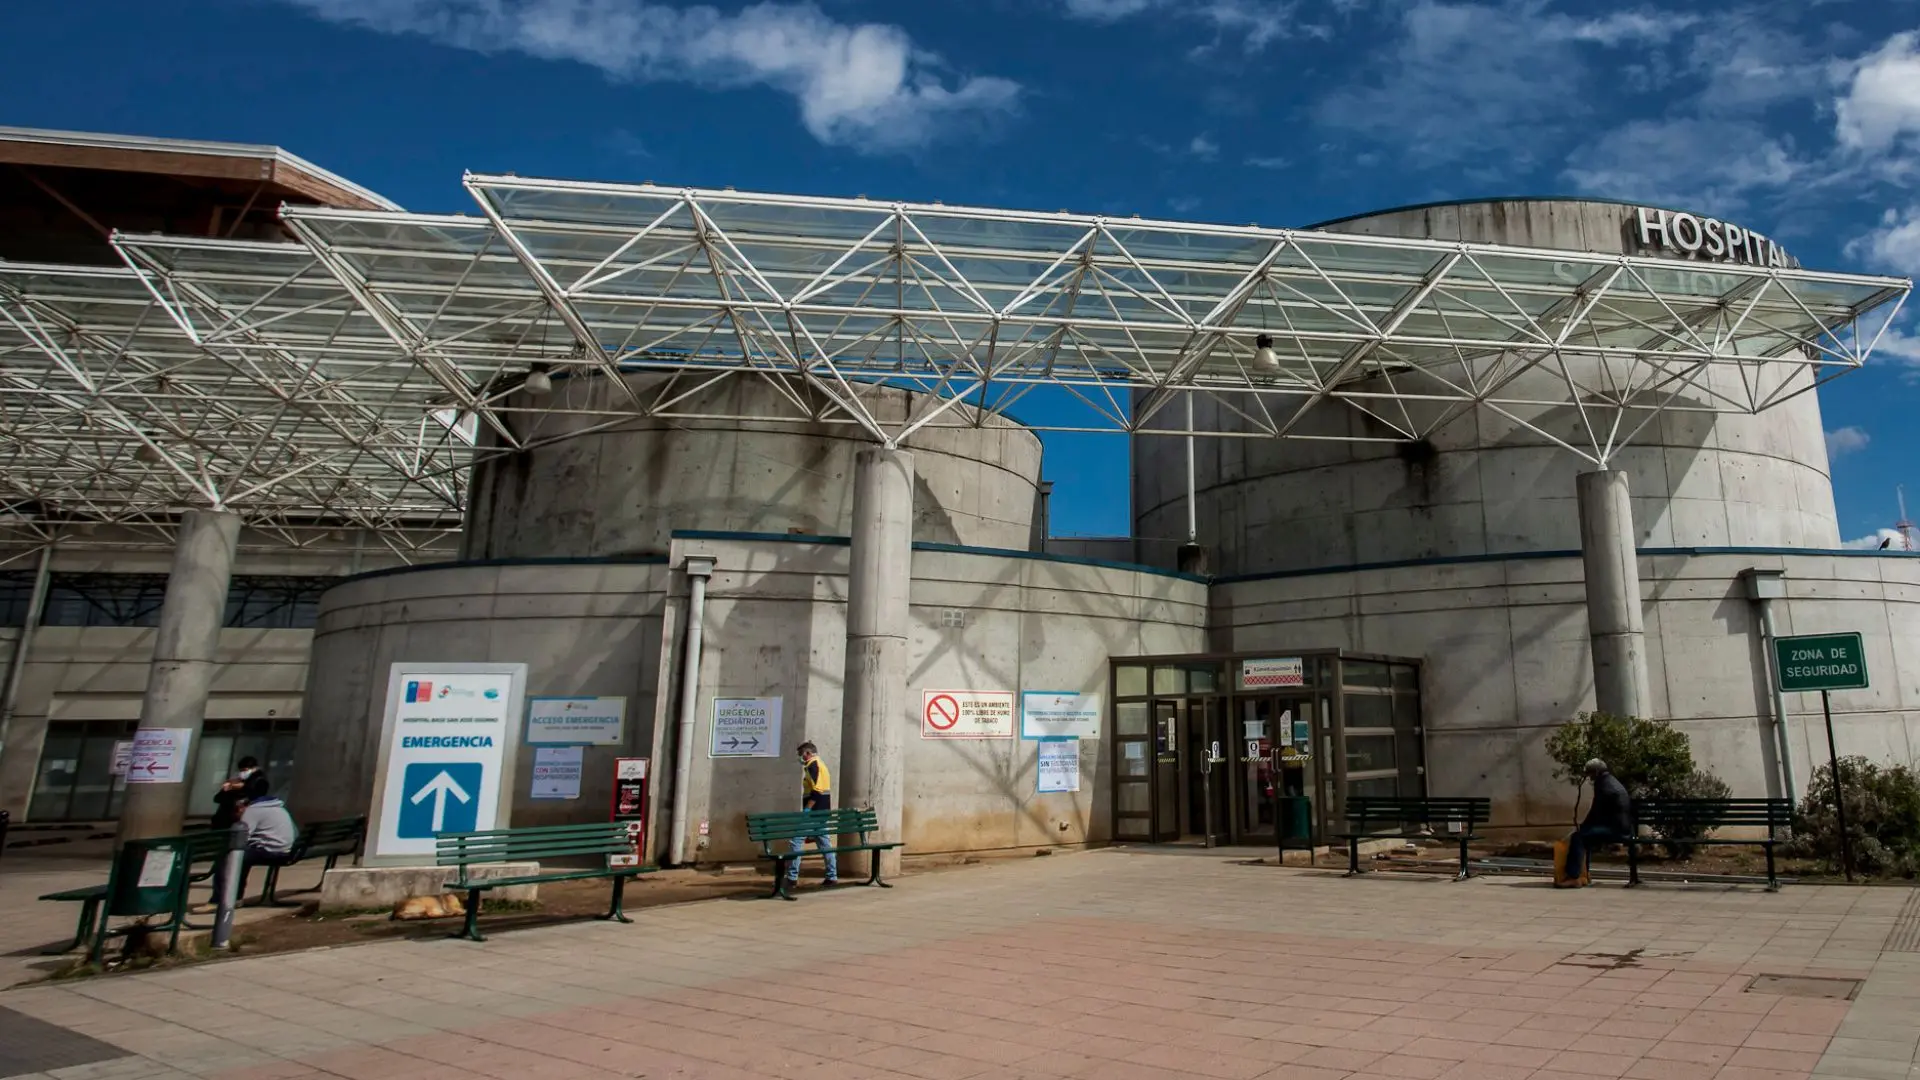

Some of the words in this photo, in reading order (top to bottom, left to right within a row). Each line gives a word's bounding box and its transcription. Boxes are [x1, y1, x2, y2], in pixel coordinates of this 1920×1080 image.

[1792, 649, 1824, 660] ZONA
[1831, 648, 1847, 659] DE
[1786, 664, 1857, 677] SEGURIDAD
[532, 716, 563, 724] ACCESO
[565, 716, 619, 724] EMERGENCIA
[718, 717, 765, 725] PEDIÁTRICA
[402, 736, 493, 748] EMERGENCIA
